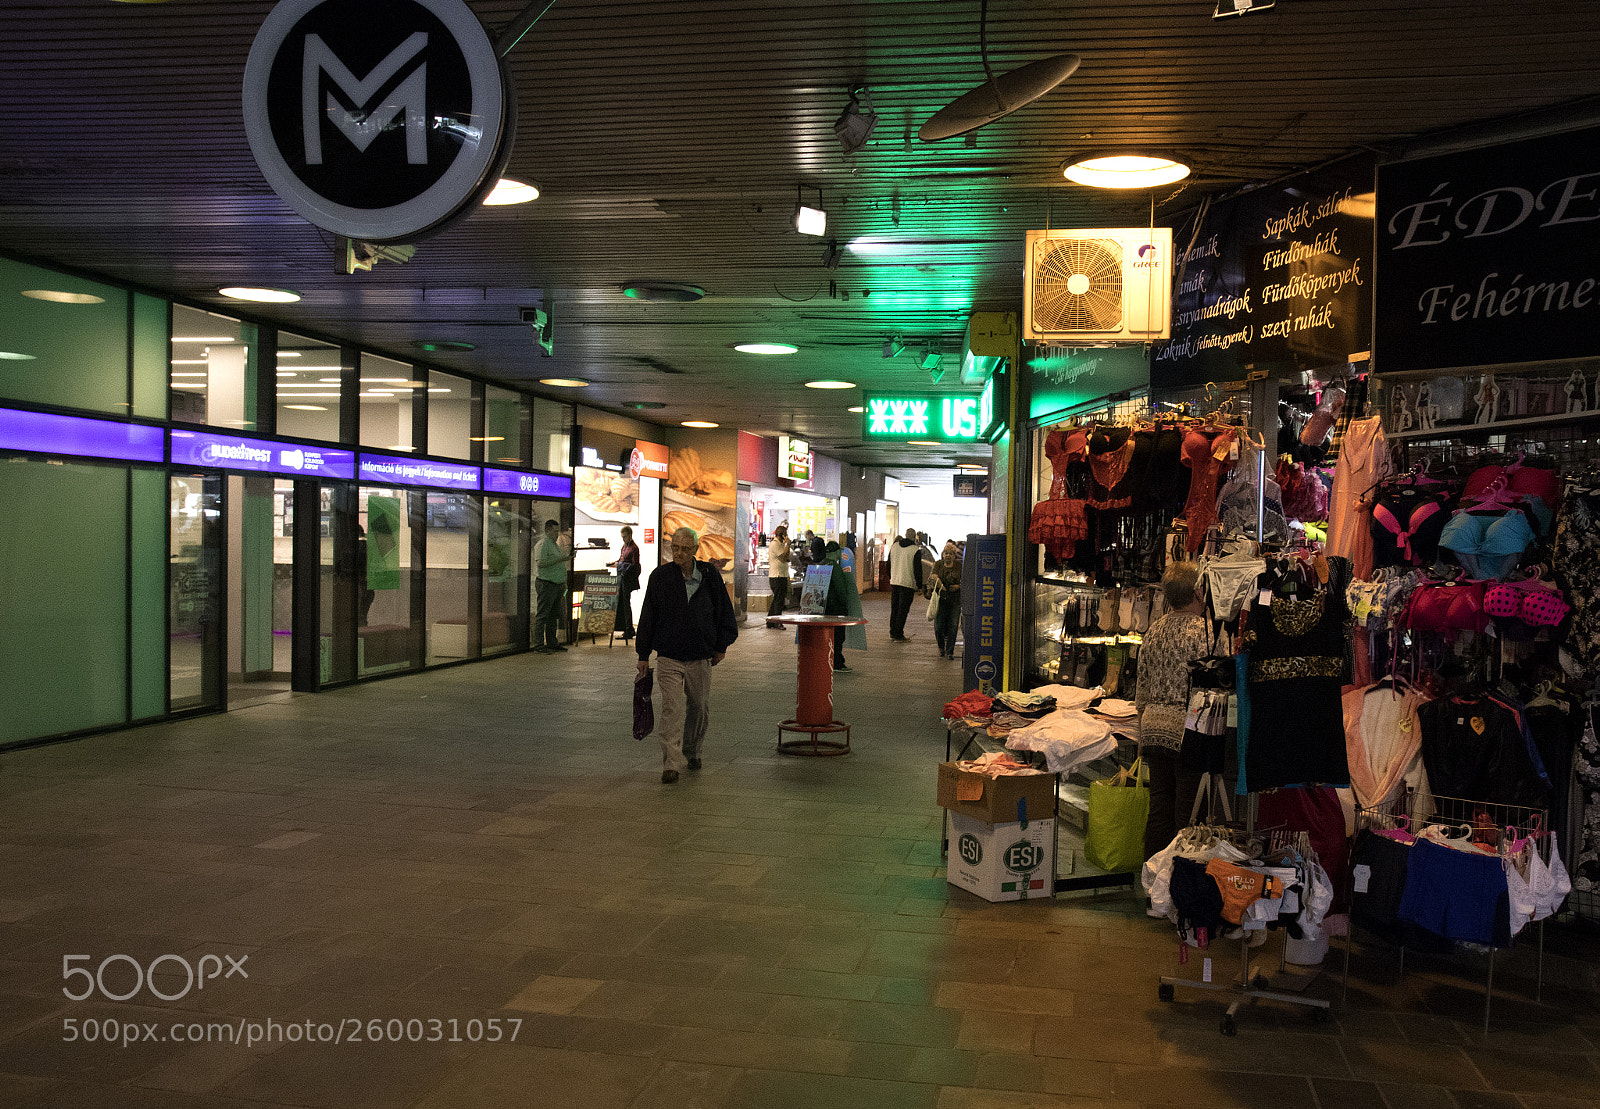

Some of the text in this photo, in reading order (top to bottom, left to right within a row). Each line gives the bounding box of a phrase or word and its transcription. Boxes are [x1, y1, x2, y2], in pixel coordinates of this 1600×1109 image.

[1262, 228, 1341, 271] Fürdőruhák
[1132, 261, 1161, 269] GREE
[1262, 258, 1364, 305] Fürdőköpenyek
[1418, 272, 1600, 325] Fehérne
[1260, 302, 1335, 339] szexi ruhák
[1156, 335, 1193, 361] Zoknik
[362, 461, 394, 473] Információ
[395, 464, 402, 474] és
[980, 576, 995, 647] EUR HUF
[962, 838, 979, 862] ESI
[1009, 846, 1039, 868] ESI
[1227, 875, 1255, 884] HELLO
